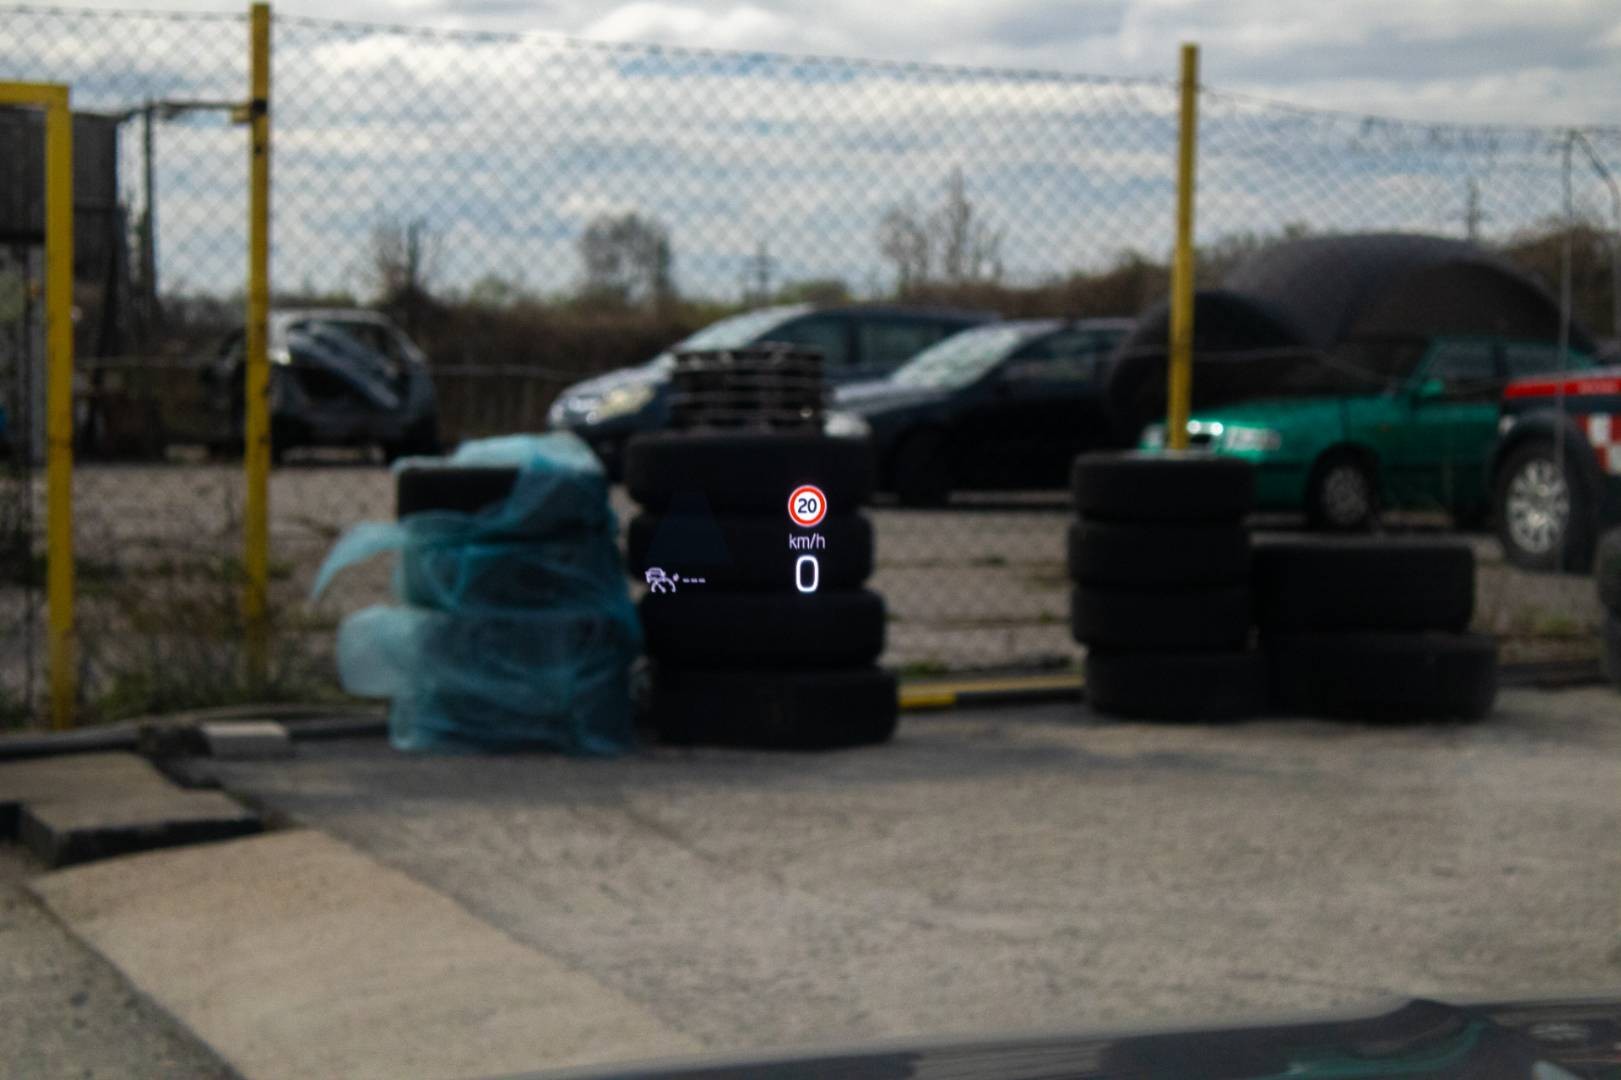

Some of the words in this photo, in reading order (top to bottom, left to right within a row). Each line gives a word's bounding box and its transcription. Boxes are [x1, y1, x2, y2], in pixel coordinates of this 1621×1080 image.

[797, 498, 817, 514] 20
[789, 533, 826, 550] km/h
[795, 555, 819, 593] 0
